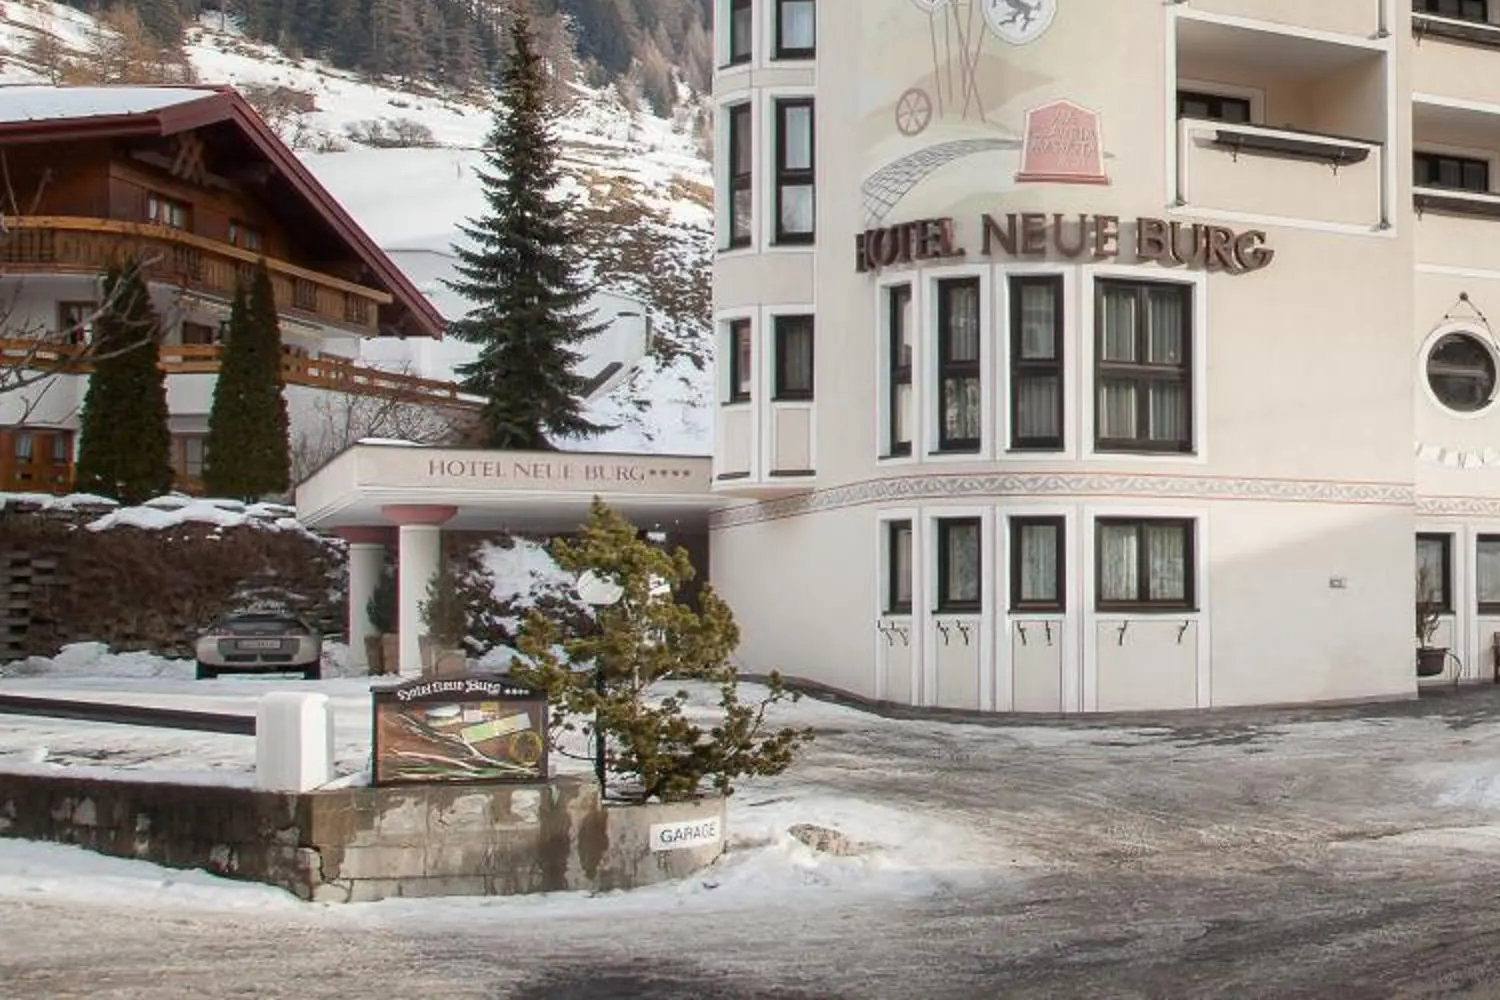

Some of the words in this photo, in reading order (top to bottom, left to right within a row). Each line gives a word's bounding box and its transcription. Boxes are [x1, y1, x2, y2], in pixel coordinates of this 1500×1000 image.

[856, 217, 965, 272] HOTEL
[981, 213, 1119, 259] NEUE
[1136, 217, 1274, 274] BURG
[428, 459, 506, 478] HOTEL
[660, 822, 717, 843] GARAGE
